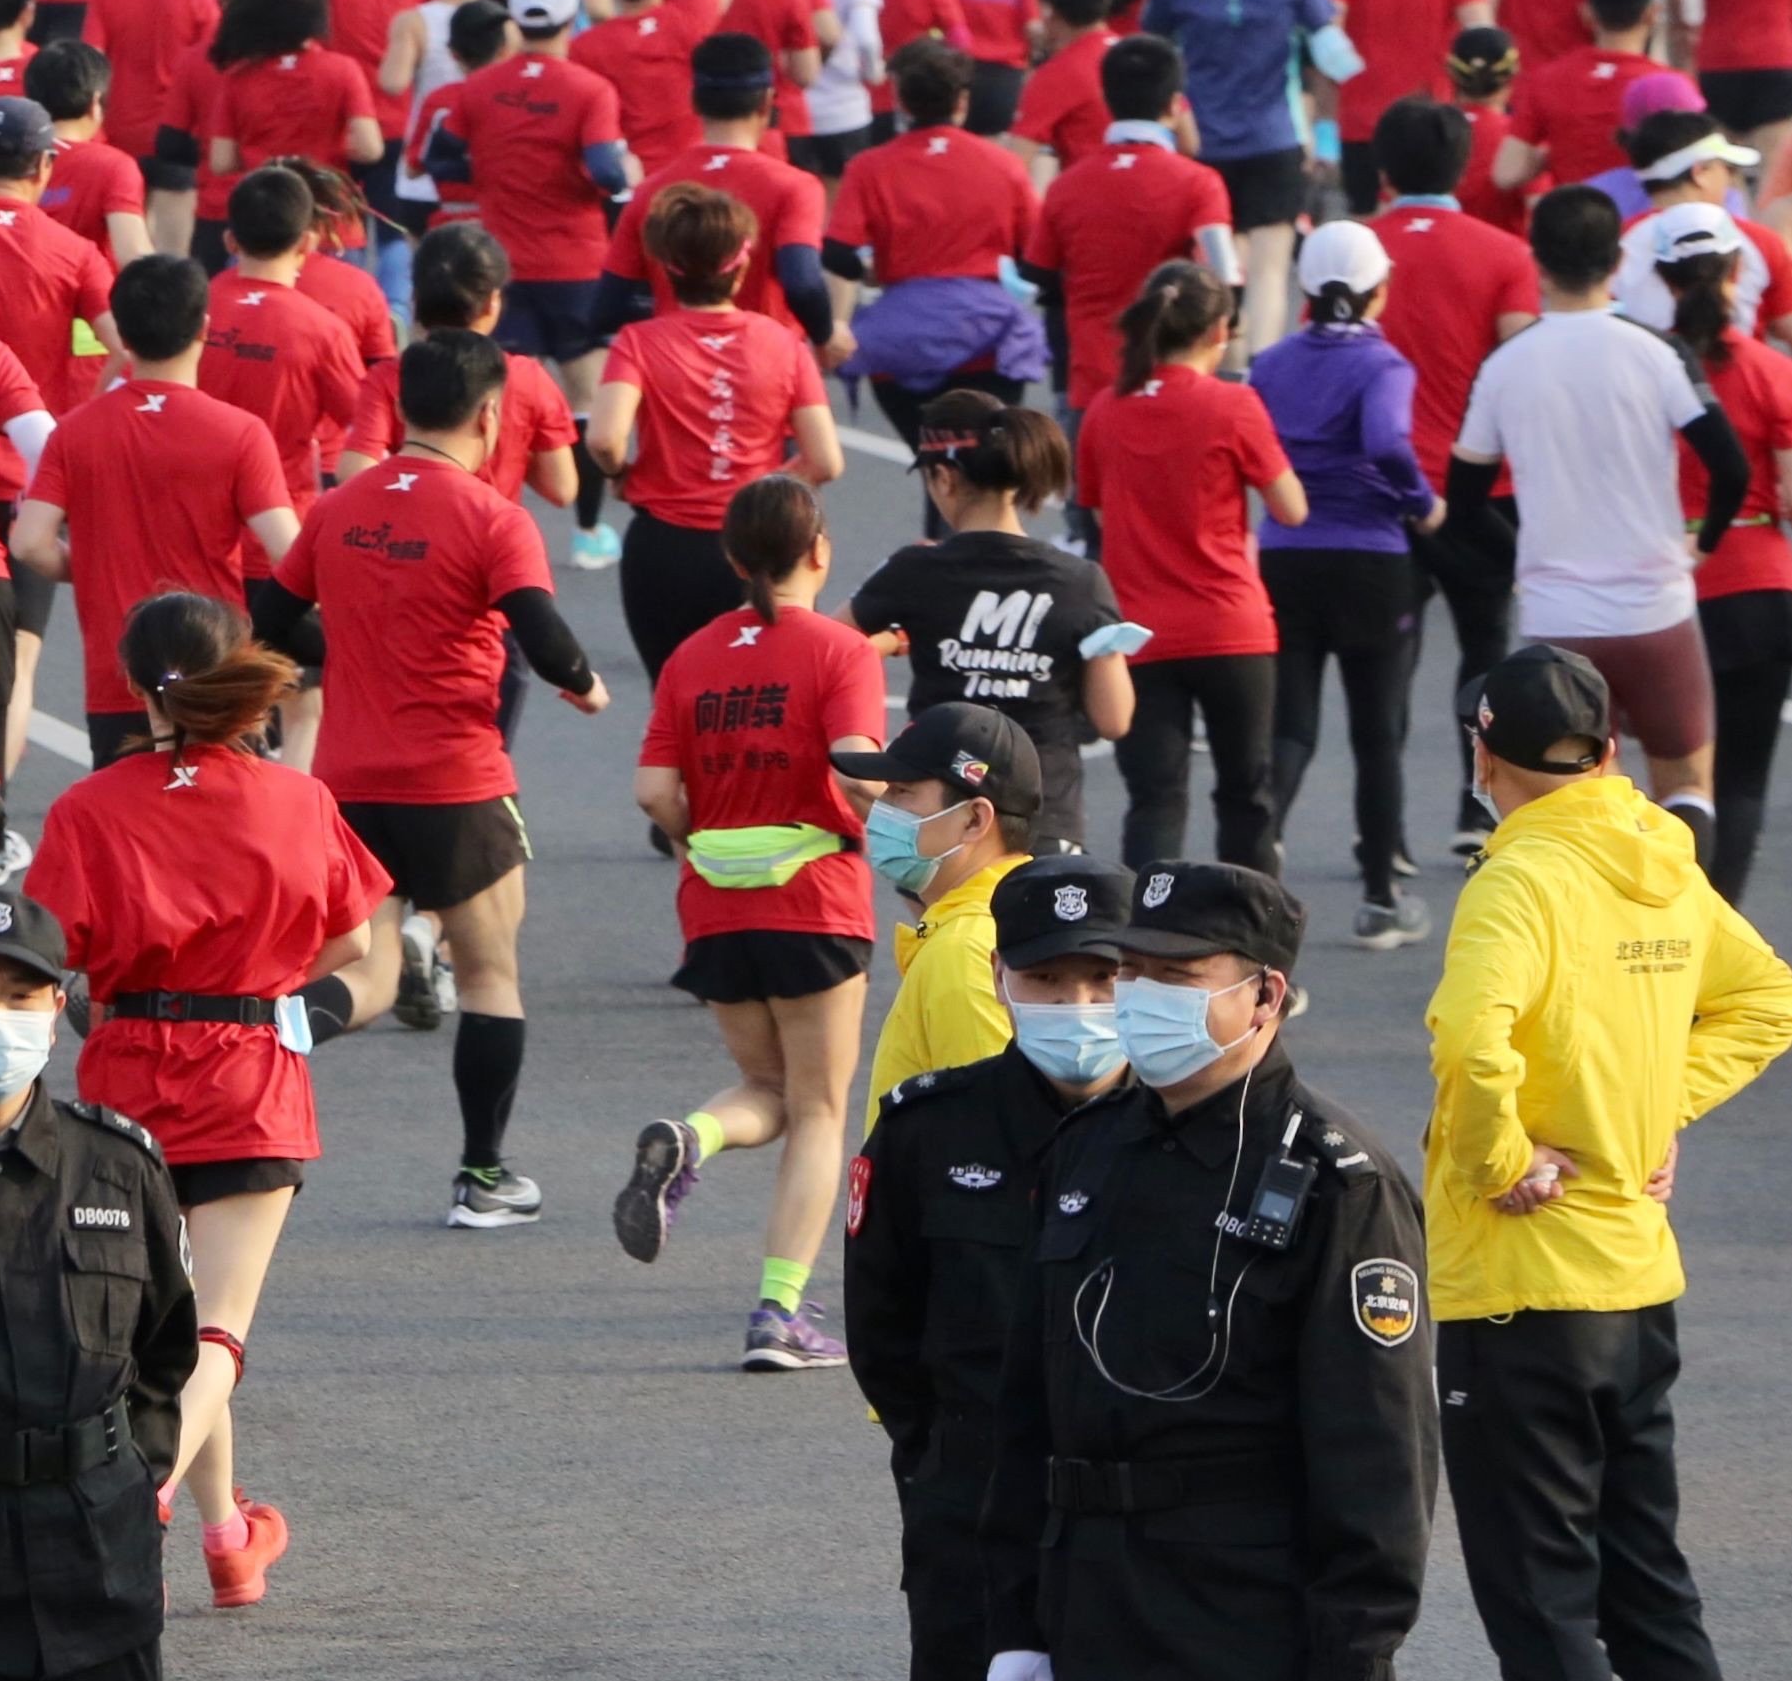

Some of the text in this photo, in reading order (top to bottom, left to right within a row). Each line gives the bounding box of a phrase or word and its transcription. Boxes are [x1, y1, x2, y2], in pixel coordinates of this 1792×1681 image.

[959, 589, 1055, 648] MI
[937, 638, 1055, 682] Running
[962, 672, 1031, 698] Team
[1615, 939, 1692, 961] 北京半程马拉松
[74, 1207, 131, 1227] DB0078
